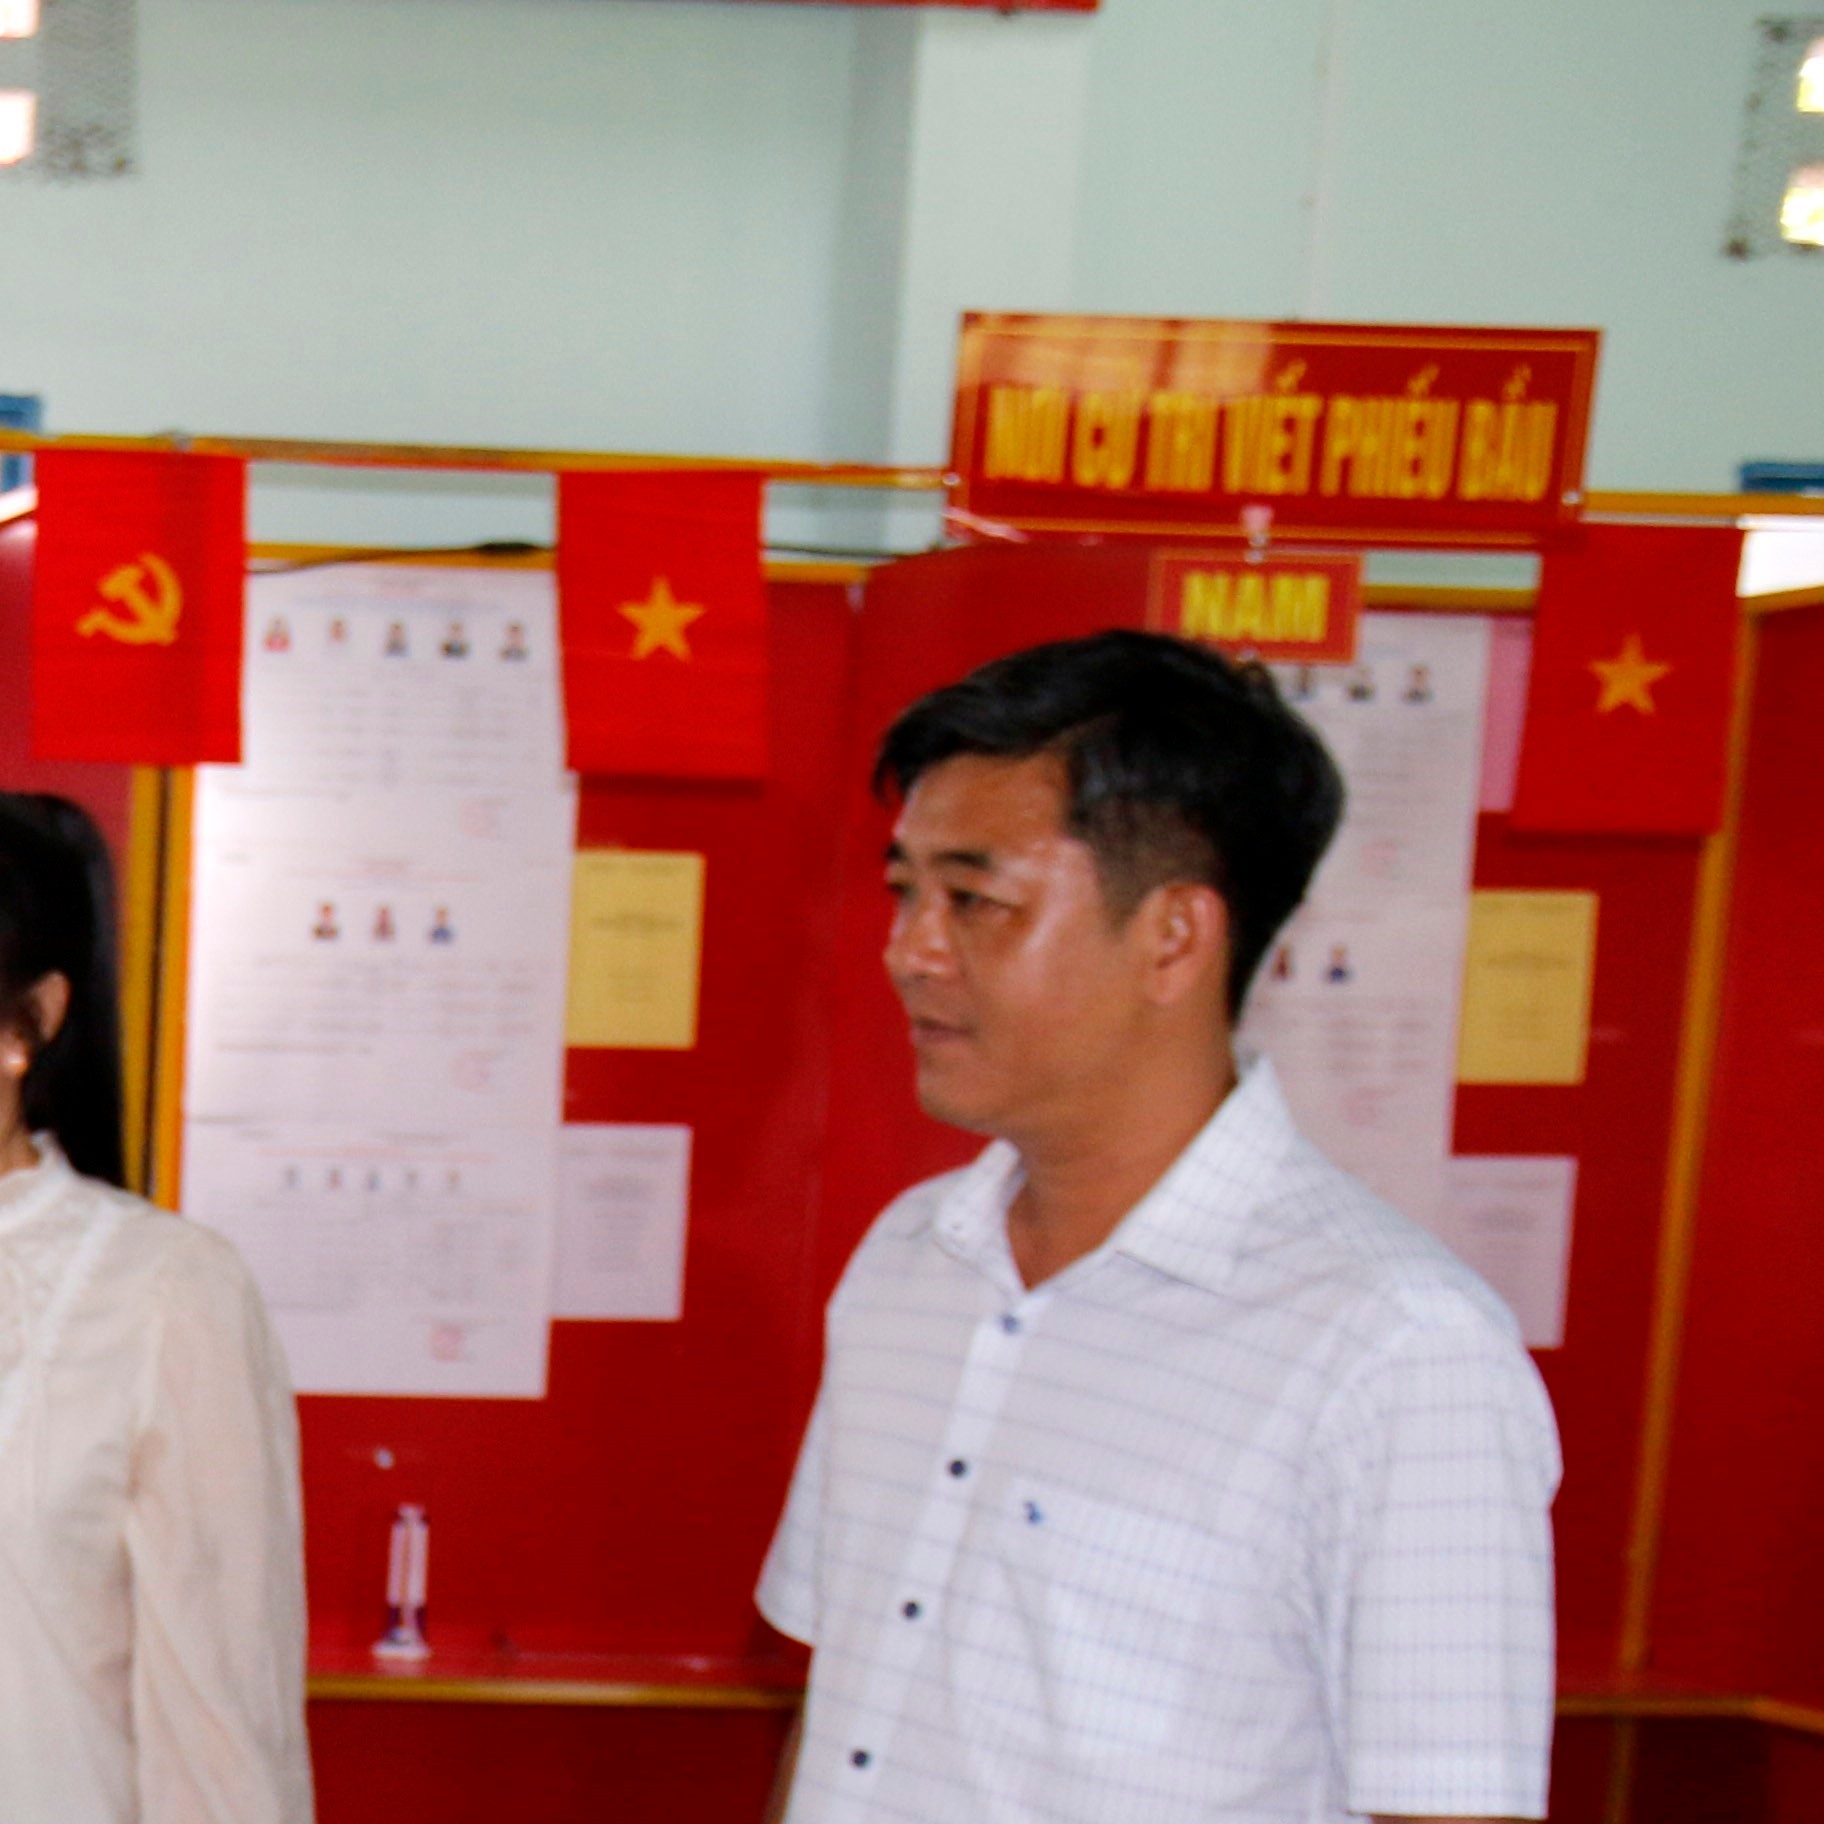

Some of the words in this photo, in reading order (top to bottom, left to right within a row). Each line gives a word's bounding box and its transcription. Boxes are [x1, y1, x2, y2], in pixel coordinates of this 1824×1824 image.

[1224, 360, 1325, 496] VIẾT
[1318, 362, 1461, 501] PHIẾU
[1179, 569, 1332, 644] NAM
